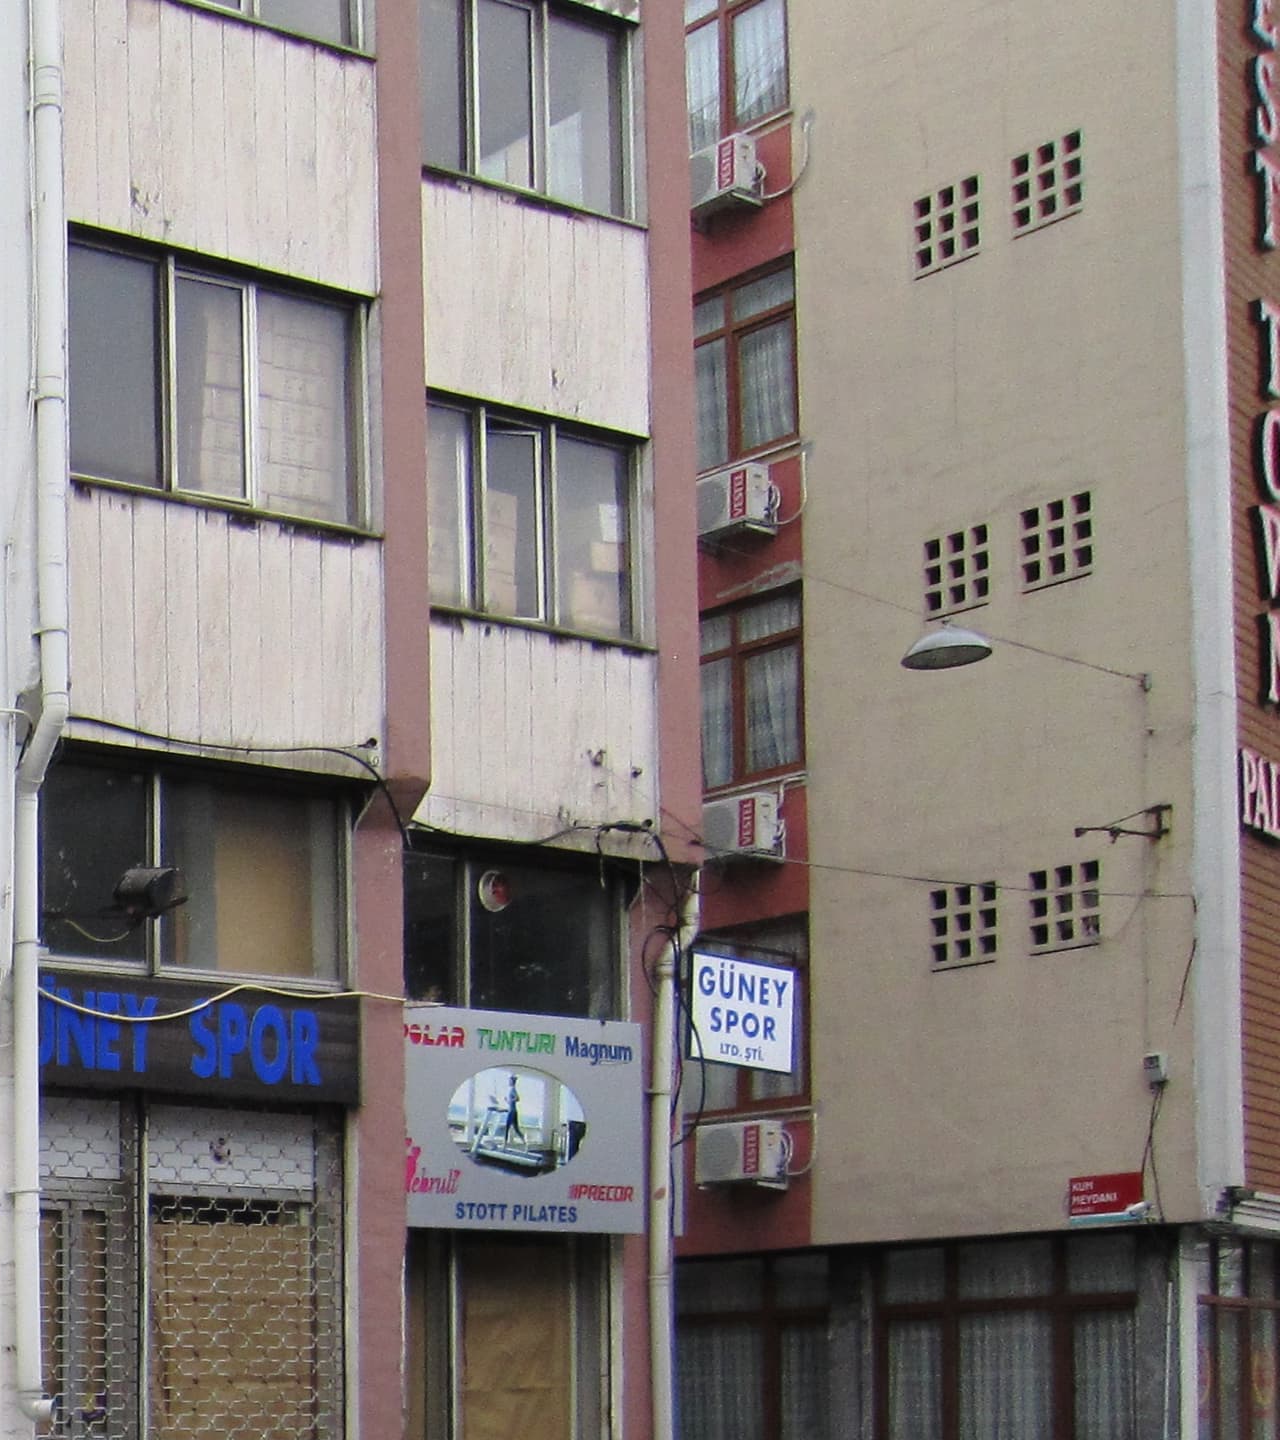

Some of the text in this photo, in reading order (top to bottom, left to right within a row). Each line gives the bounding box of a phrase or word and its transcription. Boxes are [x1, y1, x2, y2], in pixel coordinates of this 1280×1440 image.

[698, 962, 788, 1008] GÜNEY
[710, 1006, 776, 1041] SPOR
[189, 999, 322, 1086] SPOR
[477, 1028, 557, 1054] TUNTURI
[565, 1035, 633, 1065] Magnum
[720, 1043, 742, 1057] LTD.
[575, 1184, 634, 1202] PRECOR
[456, 1202, 578, 1223] STOTT PILATES
